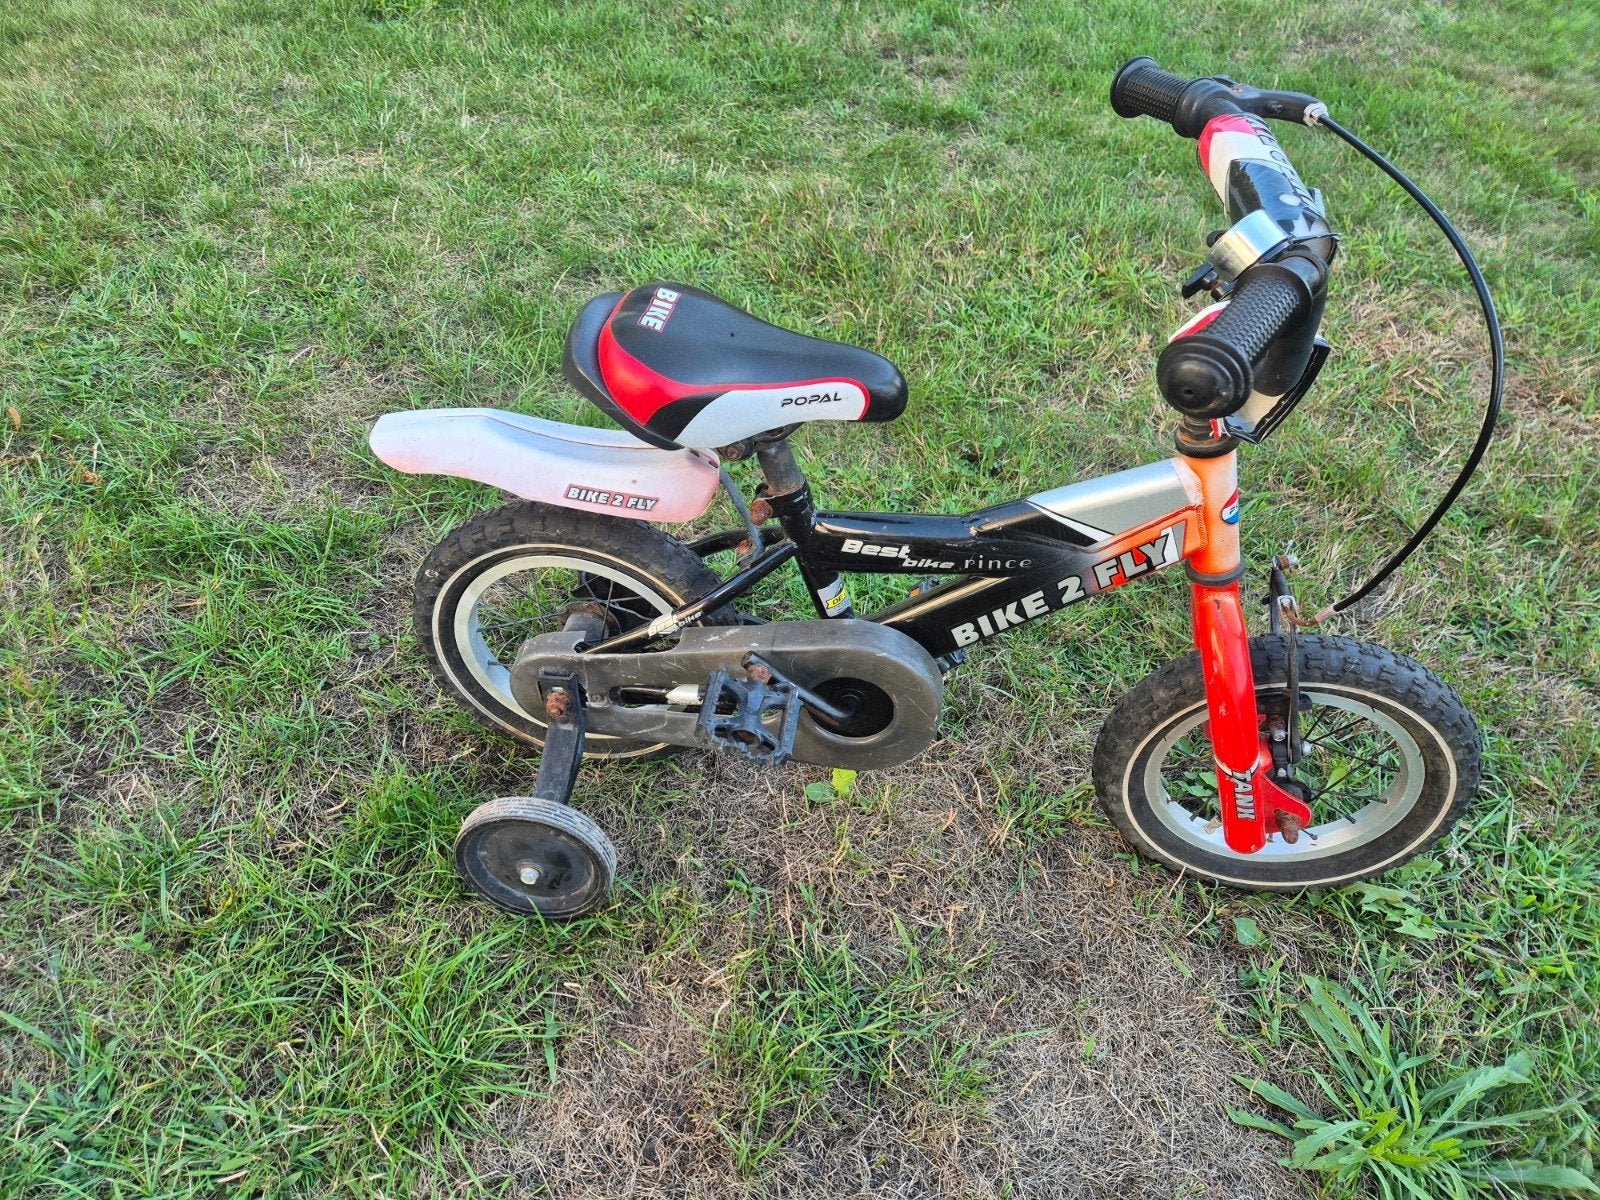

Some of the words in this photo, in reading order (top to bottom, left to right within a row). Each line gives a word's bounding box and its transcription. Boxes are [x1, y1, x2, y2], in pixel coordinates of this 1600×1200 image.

[640, 287, 680, 331] BIKE
[781, 392, 842, 408] POPAL
[567, 486, 610, 505] BIKE
[611, 494, 625, 507] 2
[626, 496, 658, 511] FLY
[841, 539, 911, 559] Best
[902, 558, 955, 569] bike
[950, 590, 1050, 648] BIKE
[1057, 574, 1086, 605] 2
[1092, 532, 1170, 590] FLY
[1230, 769, 1256, 820] TANK
